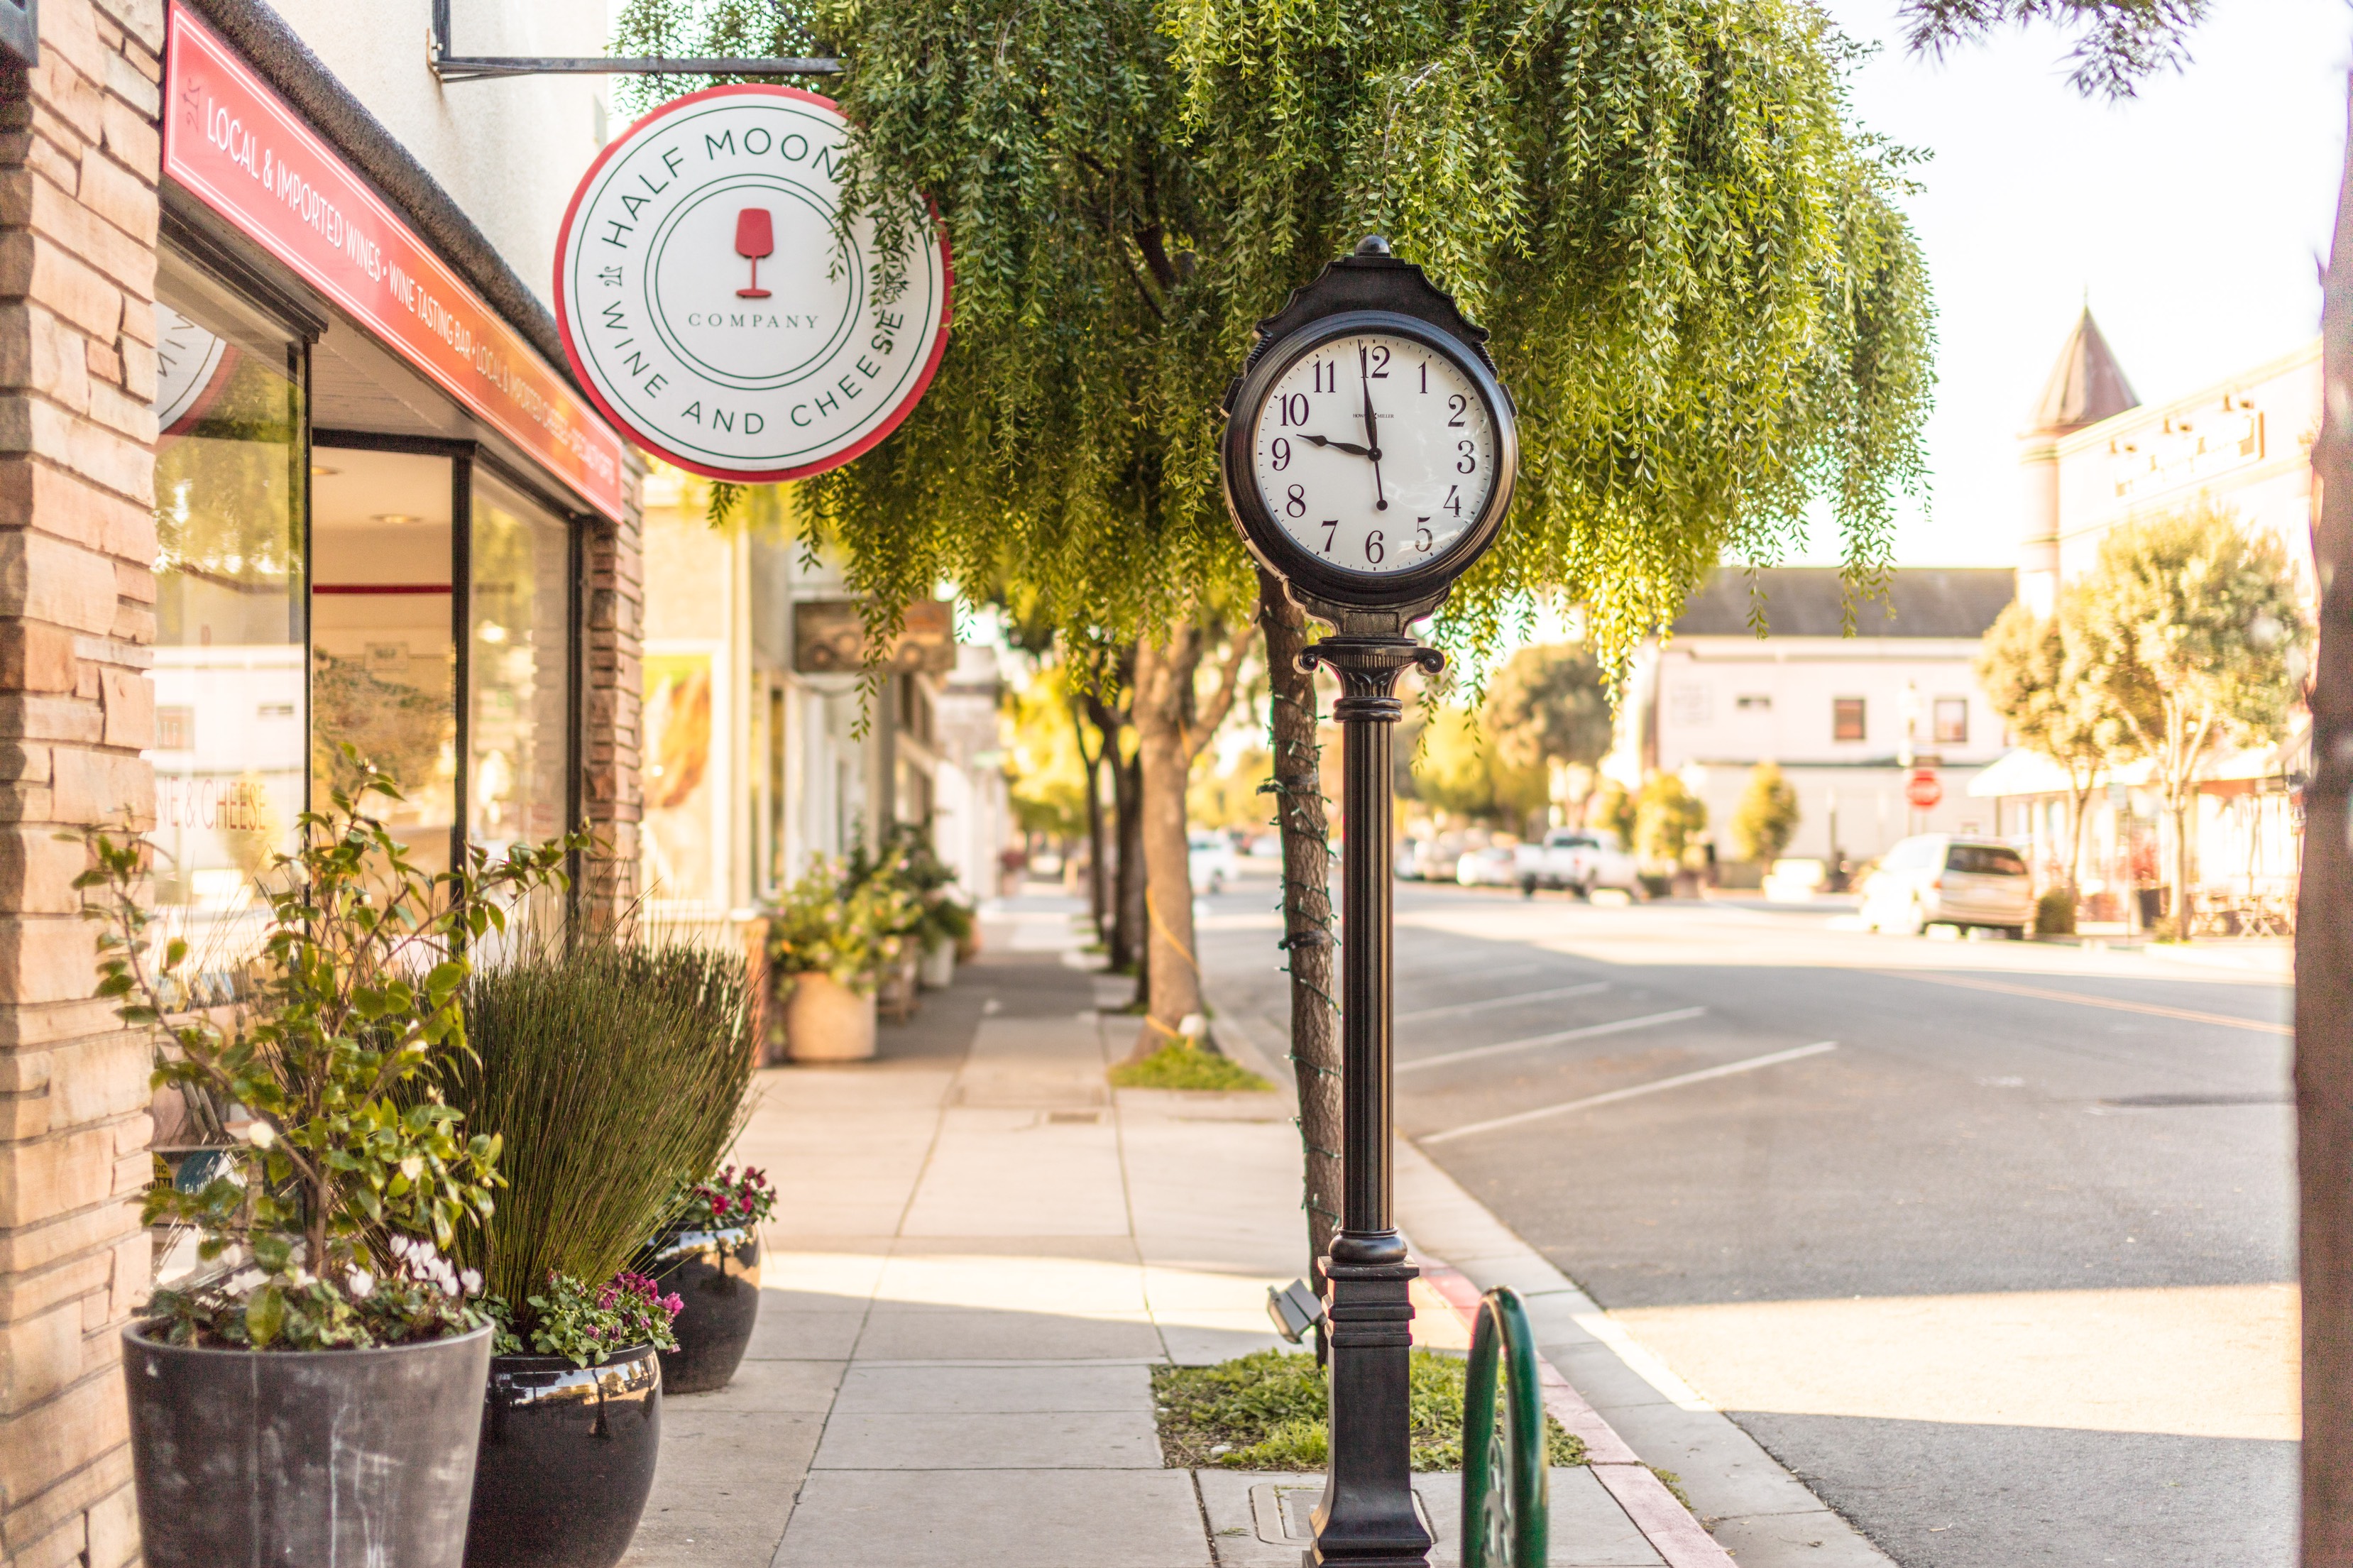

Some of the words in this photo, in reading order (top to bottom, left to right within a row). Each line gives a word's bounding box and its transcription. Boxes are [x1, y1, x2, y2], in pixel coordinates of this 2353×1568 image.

[602, 147, 684, 248] HALF
[705, 128, 845, 179] MOON
[208, 97, 258, 180] LOCAL
[263, 148, 273, 191] &
[278, 160, 342, 248] IMPORTED
[346, 220, 380, 283] WINES
[390, 260, 415, 313] WINE
[417, 285, 453, 346] TASTING
[455, 321, 471, 361] BAR
[476, 341, 502, 389] LOCAL
[689, 313, 820, 328] COMPANY
[603, 301, 669, 398] WINE
[681, 401, 764, 434] AND
[791, 309, 904, 427] CHEESE
[1312, 360, 1336, 393] 11
[1361, 346, 1390, 378] 12
[1418, 361, 1427, 394] 1
[1279, 393, 1309, 427] 10
[1448, 395, 1466, 427] 2
[1271, 437, 1290, 471] 9
[1457, 440, 1476, 473] 3
[1286, 484, 1306, 517] 8
[1443, 485, 1461, 517] 4
[1321, 520, 1339, 552] 7
[1365, 530, 1384, 564] 6
[1415, 517, 1433, 552] 5
[155, 776, 178, 828] NE
[185, 782, 196, 829] &
[202, 779, 265, 831] CHEESE
